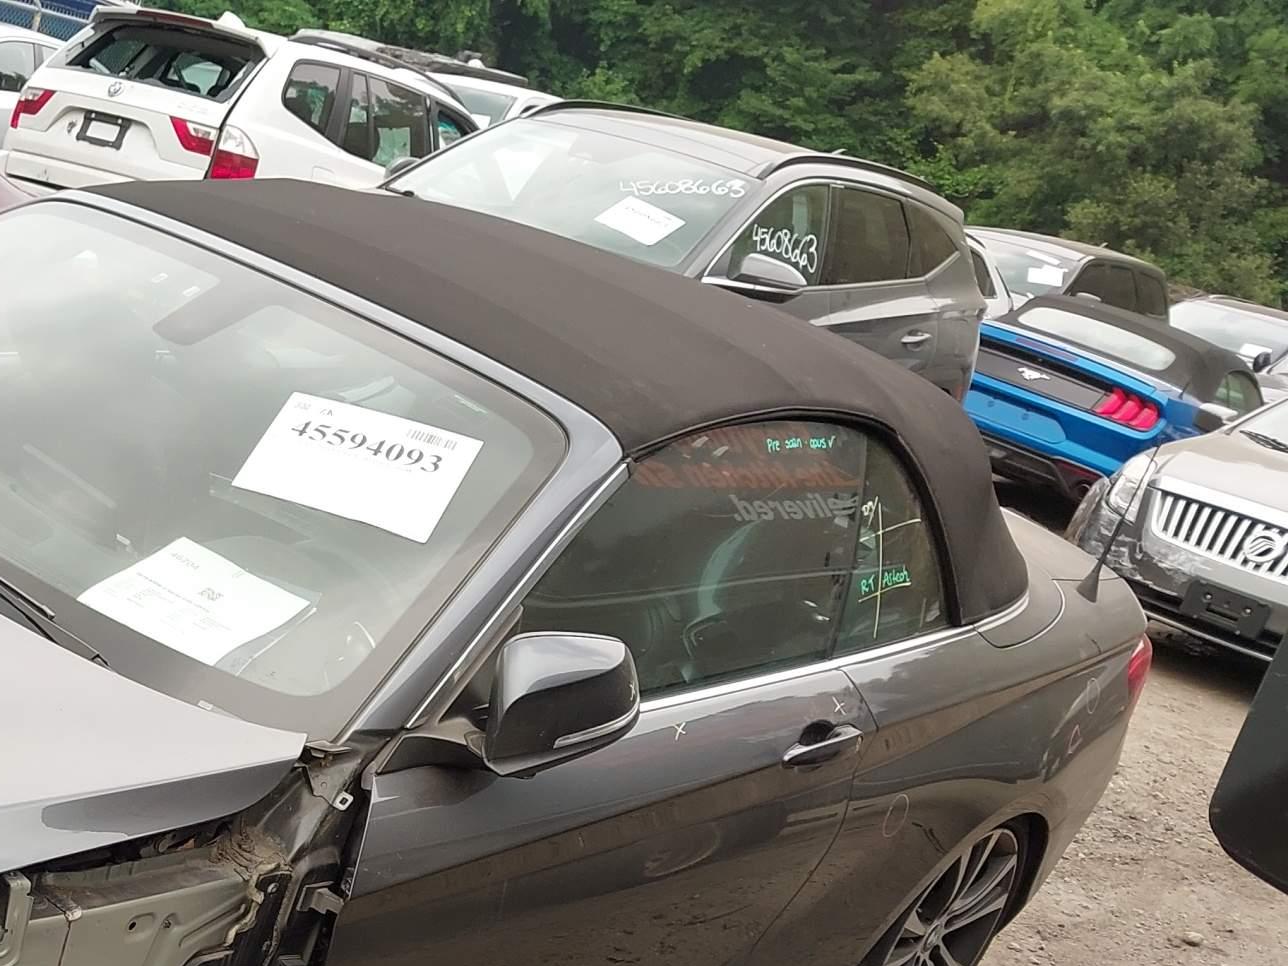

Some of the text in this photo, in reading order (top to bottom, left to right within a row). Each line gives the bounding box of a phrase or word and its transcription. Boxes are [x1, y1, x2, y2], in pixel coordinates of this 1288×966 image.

[619, 178, 746, 198] 45608663
[752, 223, 818, 273] 45608663
[291, 420, 443, 473] 45594093
[861, 574, 875, 596] RT
